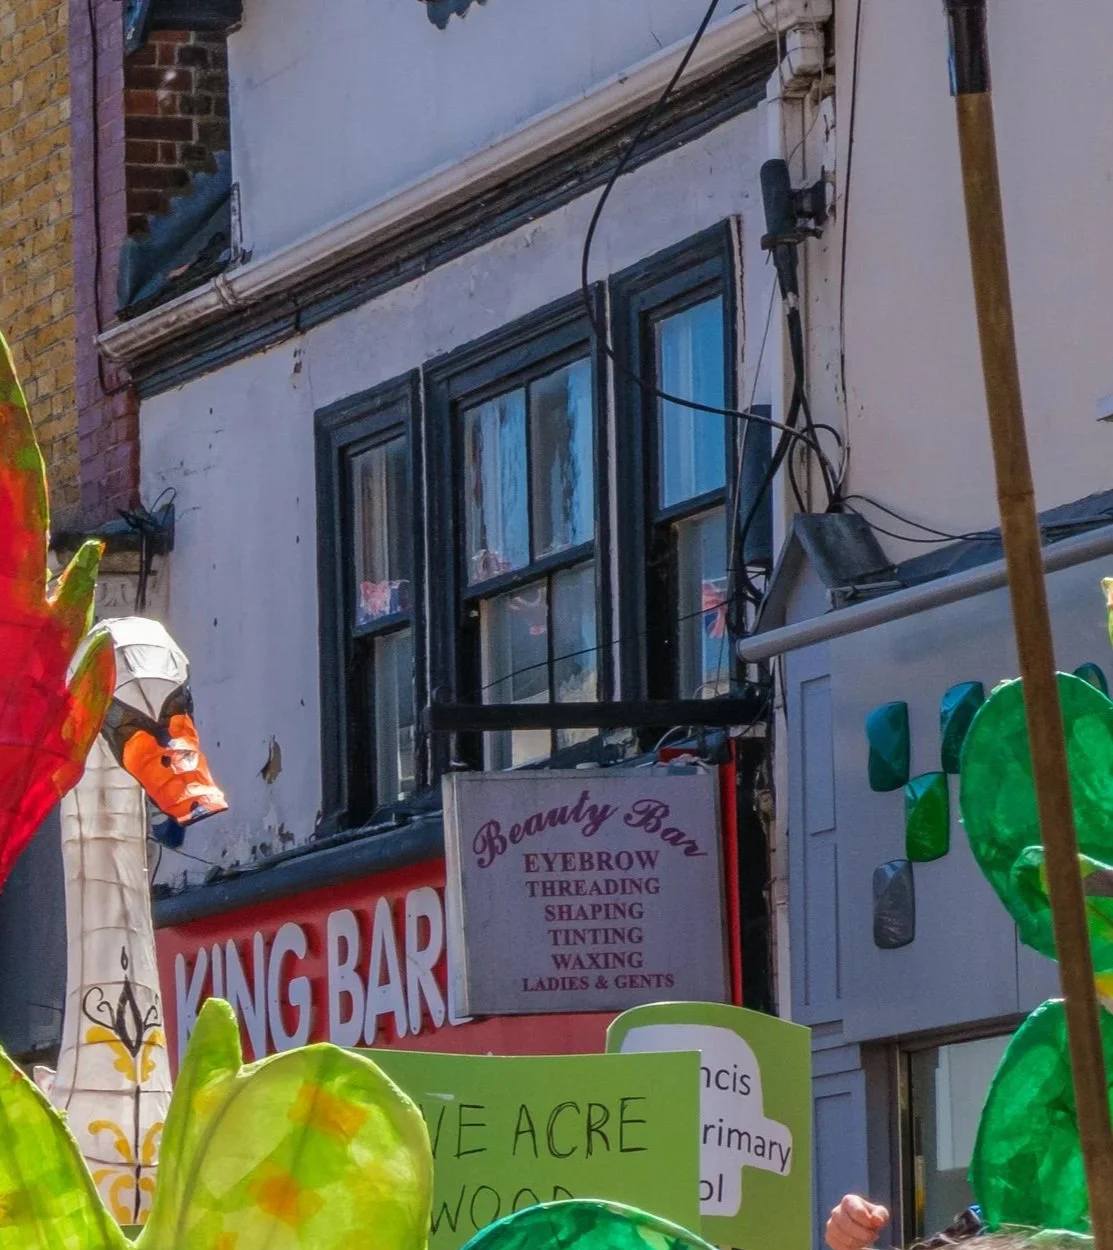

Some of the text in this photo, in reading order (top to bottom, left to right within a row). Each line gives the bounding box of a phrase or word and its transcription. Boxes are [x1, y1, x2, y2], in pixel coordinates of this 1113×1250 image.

[473, 790, 708, 869] Beauty Bar
[523, 850, 660, 873] EYEBROW
[525, 878, 660, 898] THREADING
[544, 903, 644, 922] SHAPING
[548, 927, 644, 946] TINTING
[551, 952, 644, 971] WAXING
[523, 973, 675, 992] LADIES & GENTS
[512, 1096, 648, 1159] ACRE
